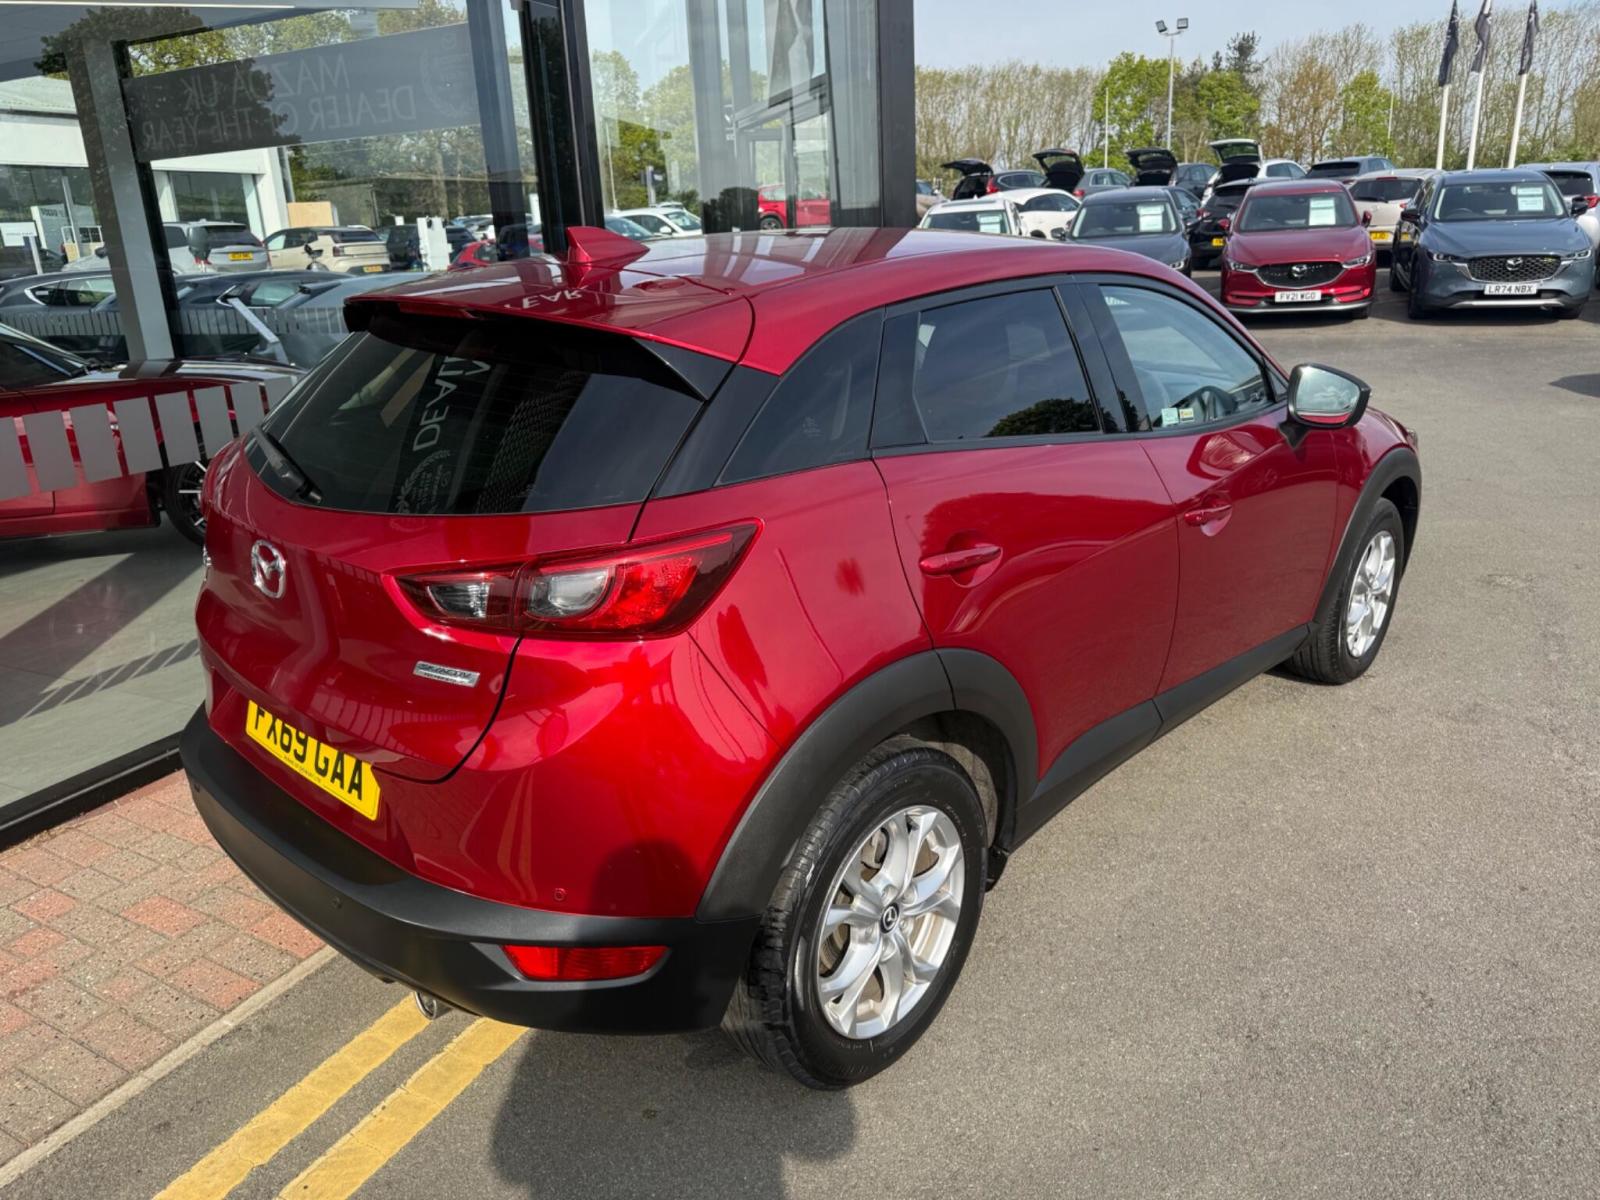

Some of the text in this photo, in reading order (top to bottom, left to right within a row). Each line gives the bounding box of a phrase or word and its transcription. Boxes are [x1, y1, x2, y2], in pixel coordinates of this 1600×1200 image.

[1488, 285, 1512, 294] LR74
[254, 706, 309, 764] FX69
[314, 741, 363, 801] GAA
